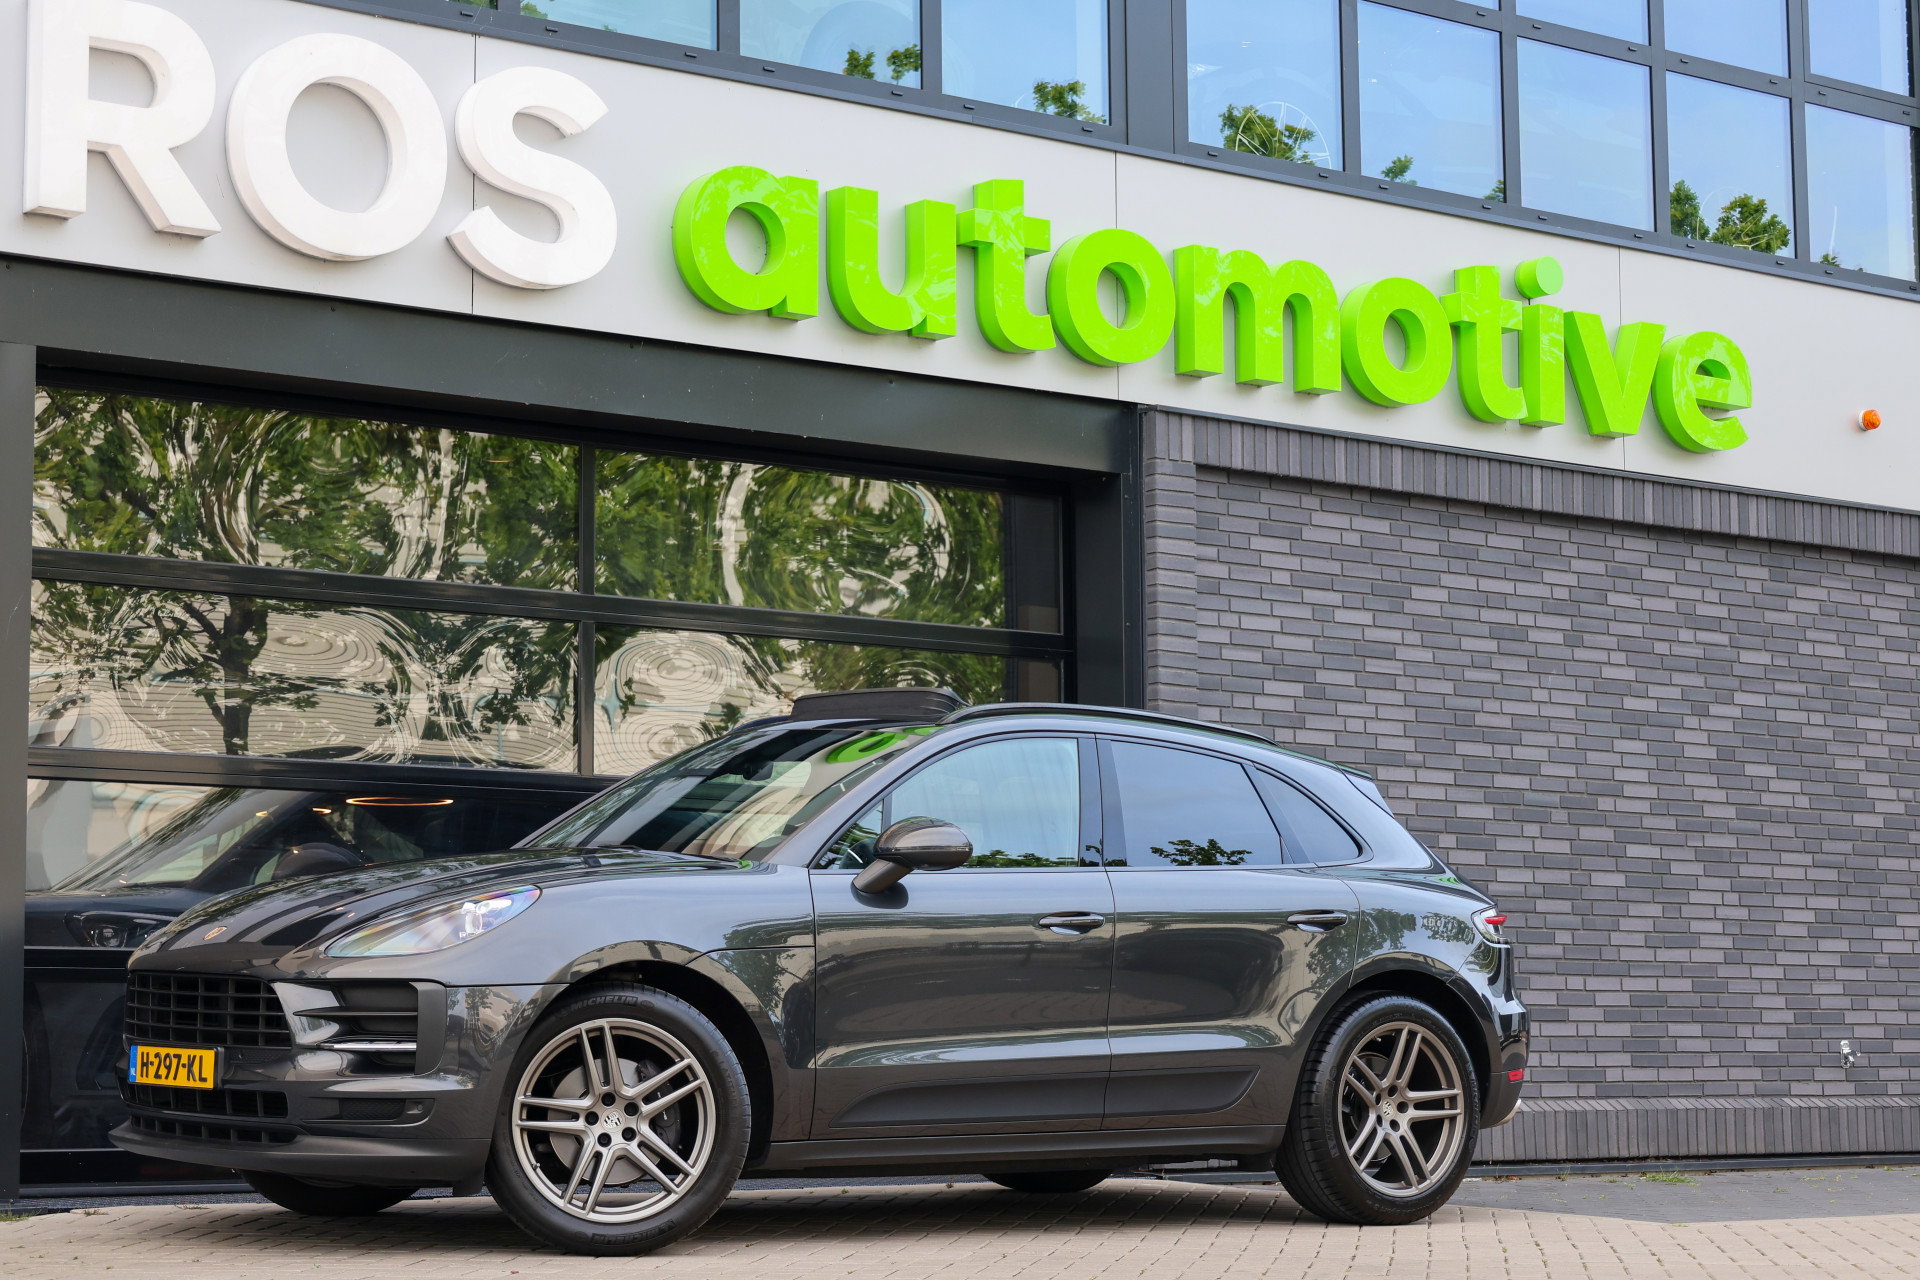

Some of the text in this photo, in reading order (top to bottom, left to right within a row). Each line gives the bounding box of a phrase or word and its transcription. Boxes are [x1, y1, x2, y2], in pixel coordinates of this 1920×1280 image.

[23, 0, 1753, 453] ROS automotive
[141, 1051, 207, 1082] H-297-KL
